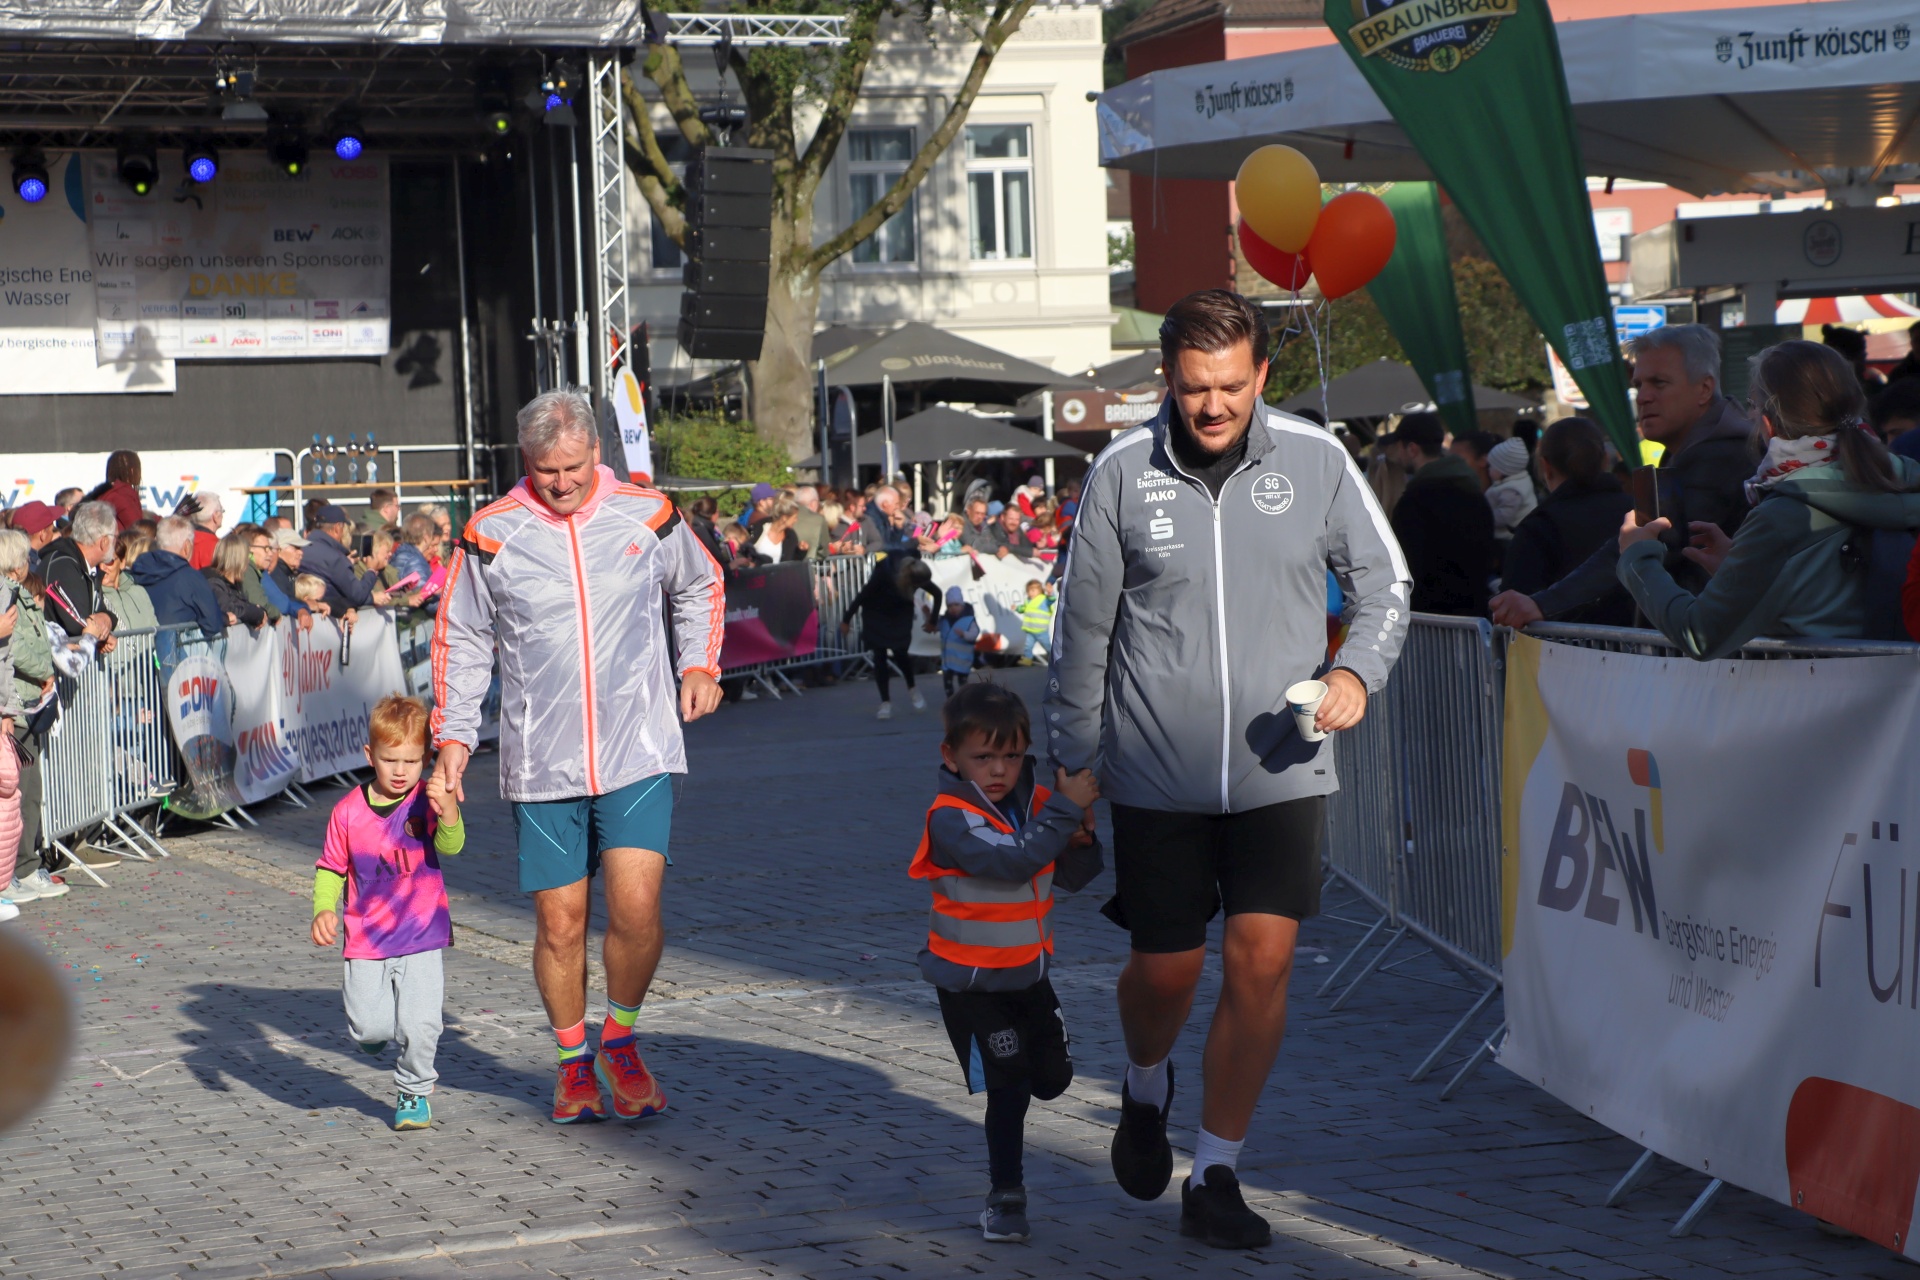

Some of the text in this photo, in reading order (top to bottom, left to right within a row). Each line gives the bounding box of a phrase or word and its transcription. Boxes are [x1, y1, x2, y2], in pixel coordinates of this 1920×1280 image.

[1413, 25, 1467, 53] BRAUEREI
[1738, 27, 1888, 69] Zunft KÖLSCH
[1205, 80, 1282, 119] Zunft KÖLSCH
[273, 229, 314, 242] BEW
[331, 227, 364, 241] AOK
[95, 251, 384, 271] Wir sagen unseren Sponsoren
[189, 272, 298, 296] DANKE
[5, 290, 71, 306] Wasser
[624, 429, 642, 444] BEW
[1136, 474, 1180, 489] ENGSTFELD
[1264, 477, 1279, 490] SG
[1144, 489, 1177, 503] JAKO
[1144, 543, 1185, 553] Kreissparkasse
[1158, 550, 1171, 558] Köln
[1537, 781, 1660, 940] BEW
[1663, 909, 1777, 981] Bergische Energie
[1668, 970, 1735, 1023] und Wasser
